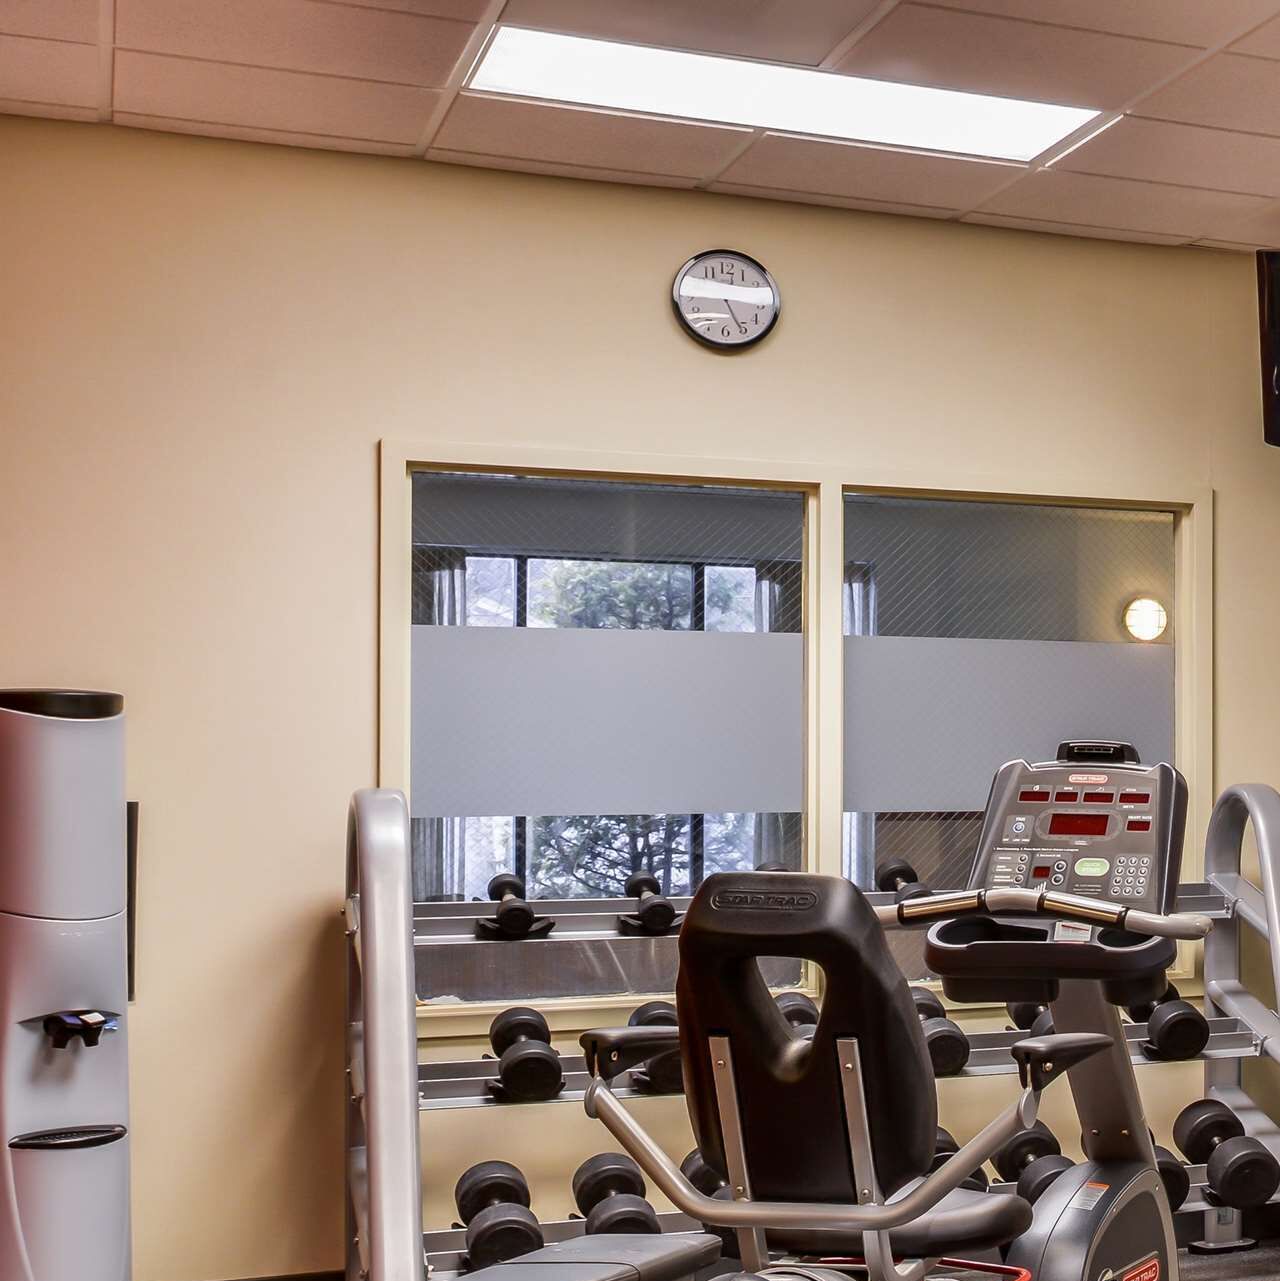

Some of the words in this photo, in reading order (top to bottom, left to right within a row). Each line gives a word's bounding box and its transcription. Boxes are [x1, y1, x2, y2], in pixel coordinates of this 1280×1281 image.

[704, 266, 715, 279] 11
[720, 261, 734, 276] 12
[721, 325, 730, 338] 6
[717, 894, 765, 906] STAR
[765, 894, 811, 906] TRAC
